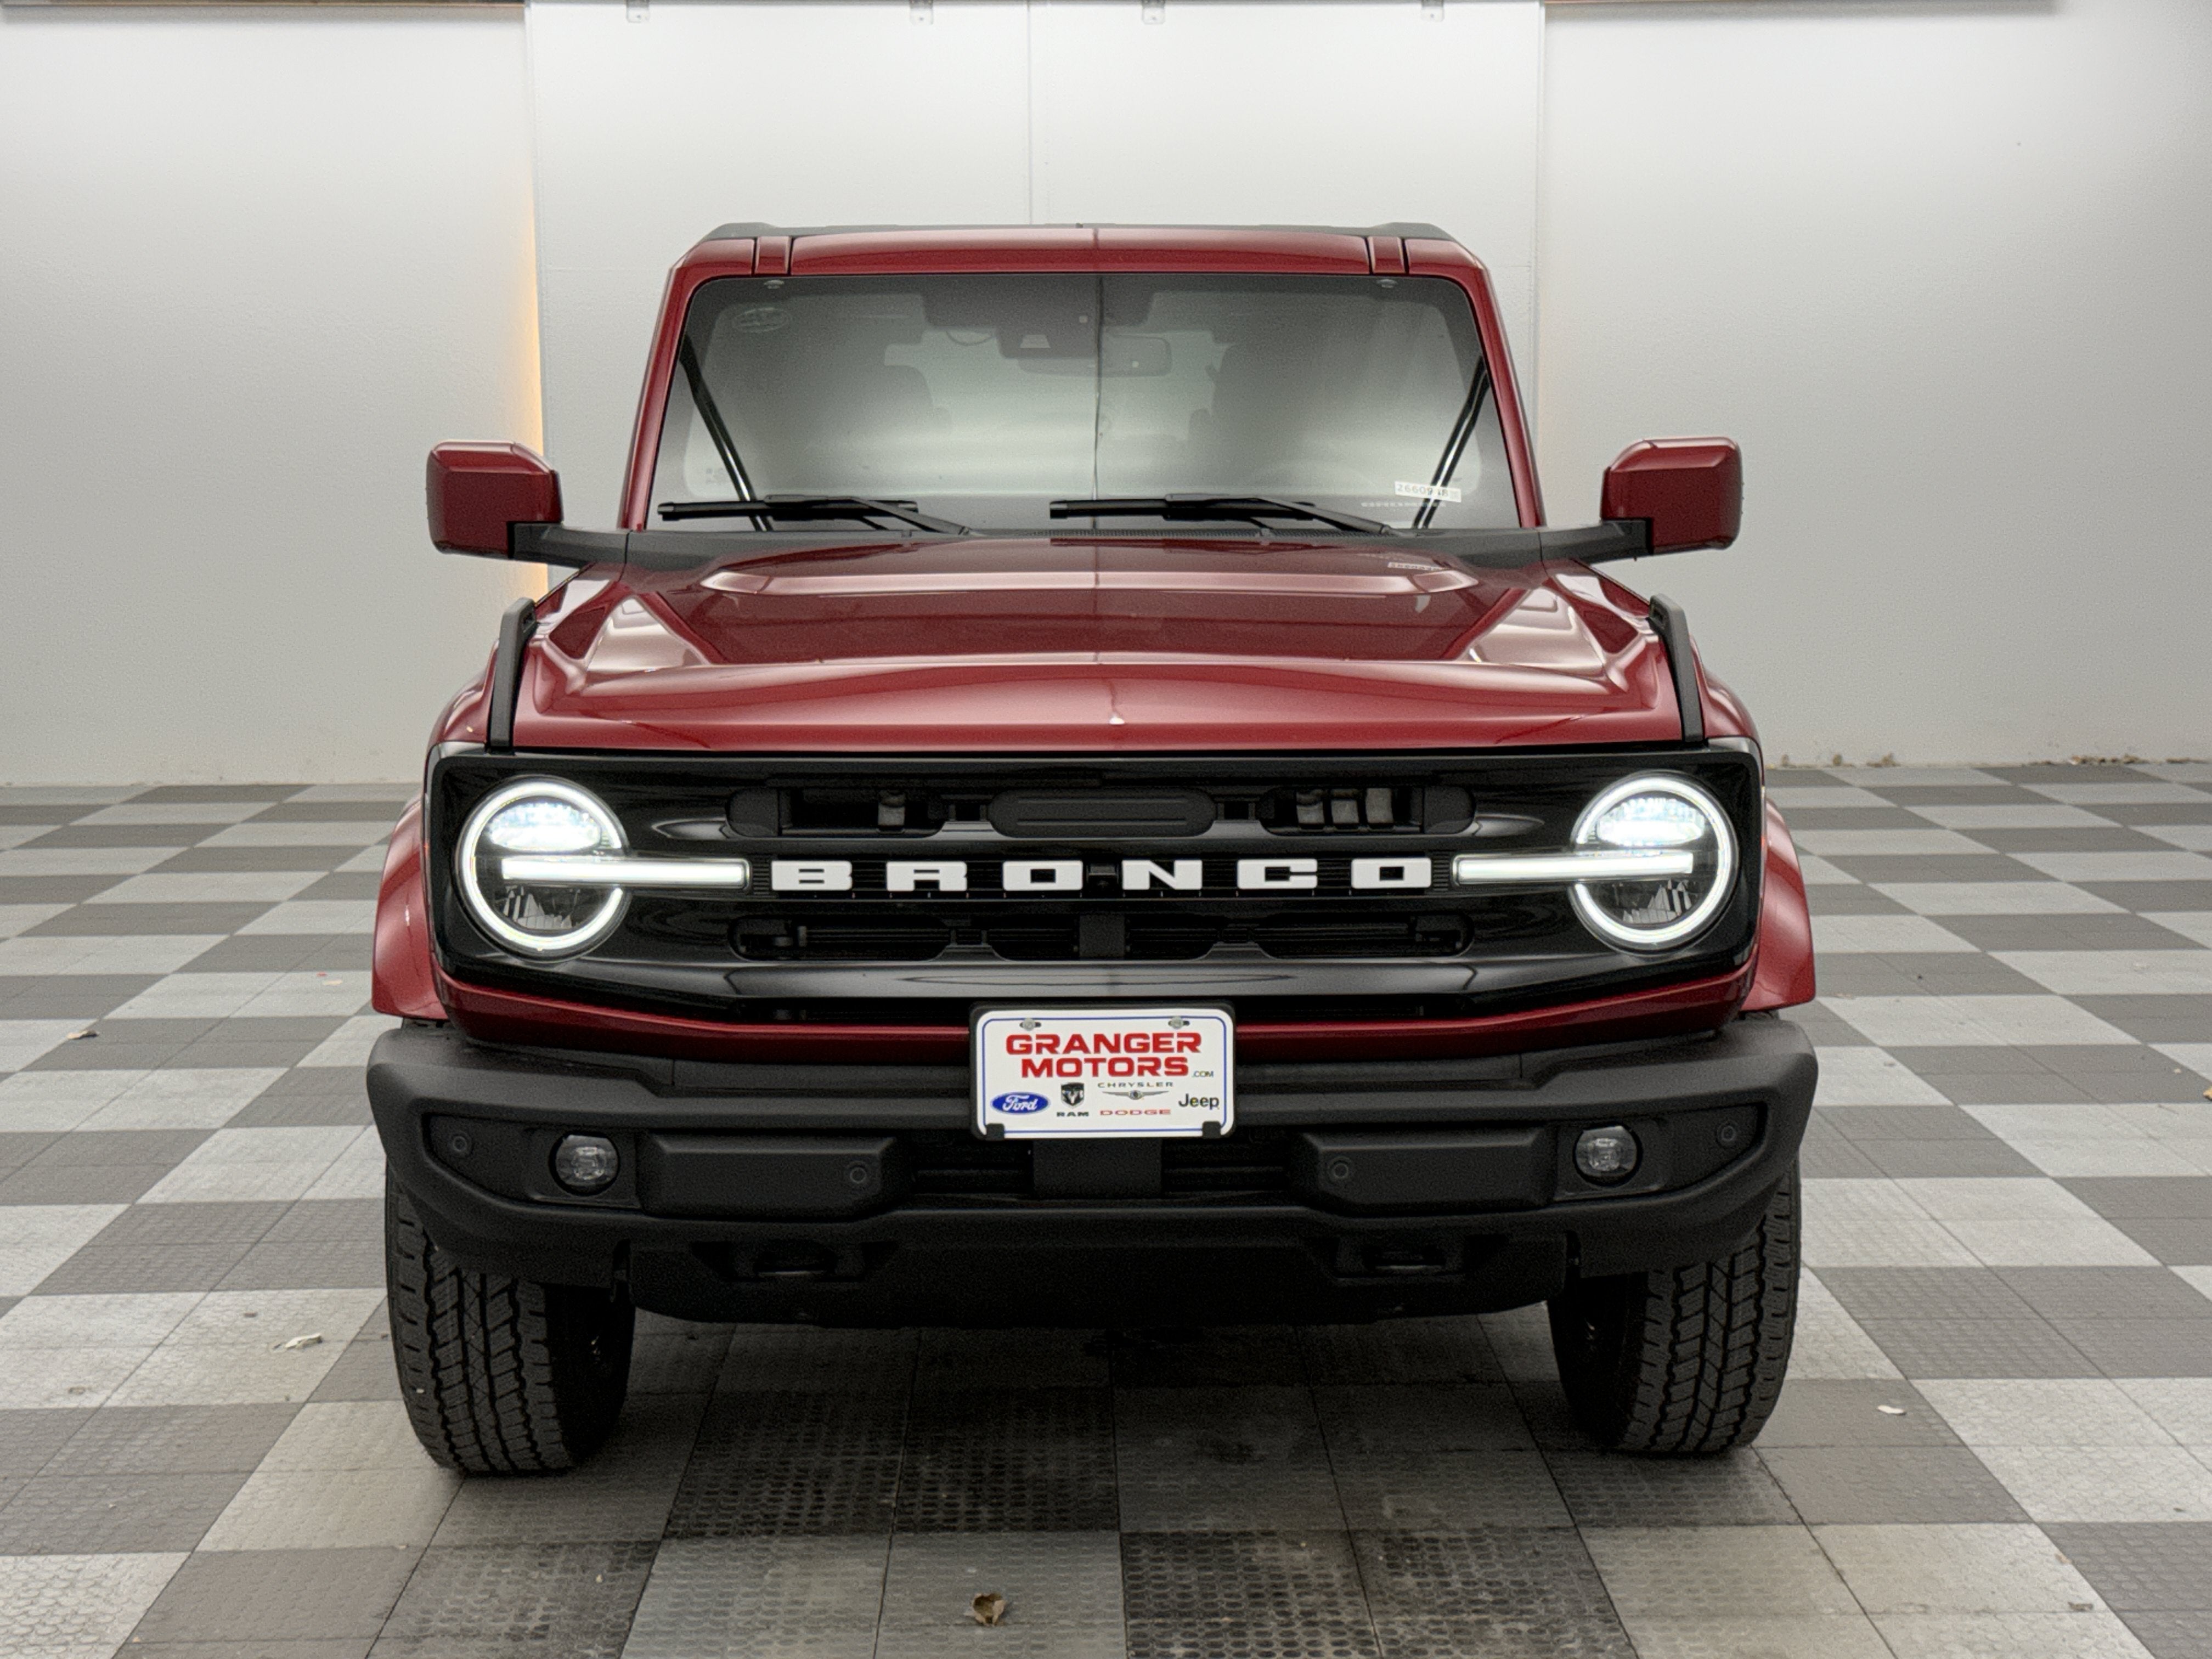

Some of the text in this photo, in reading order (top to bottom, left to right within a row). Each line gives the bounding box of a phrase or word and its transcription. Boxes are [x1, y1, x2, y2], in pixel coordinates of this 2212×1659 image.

[771, 858, 1431, 892] BRONCO
[1006, 1032, 1202, 1055] GRANGER
[1021, 1056, 1189, 1079] MOTORS
[1002, 1094, 1039, 1112] Ford
[1178, 1093, 1220, 1110] Jeep
